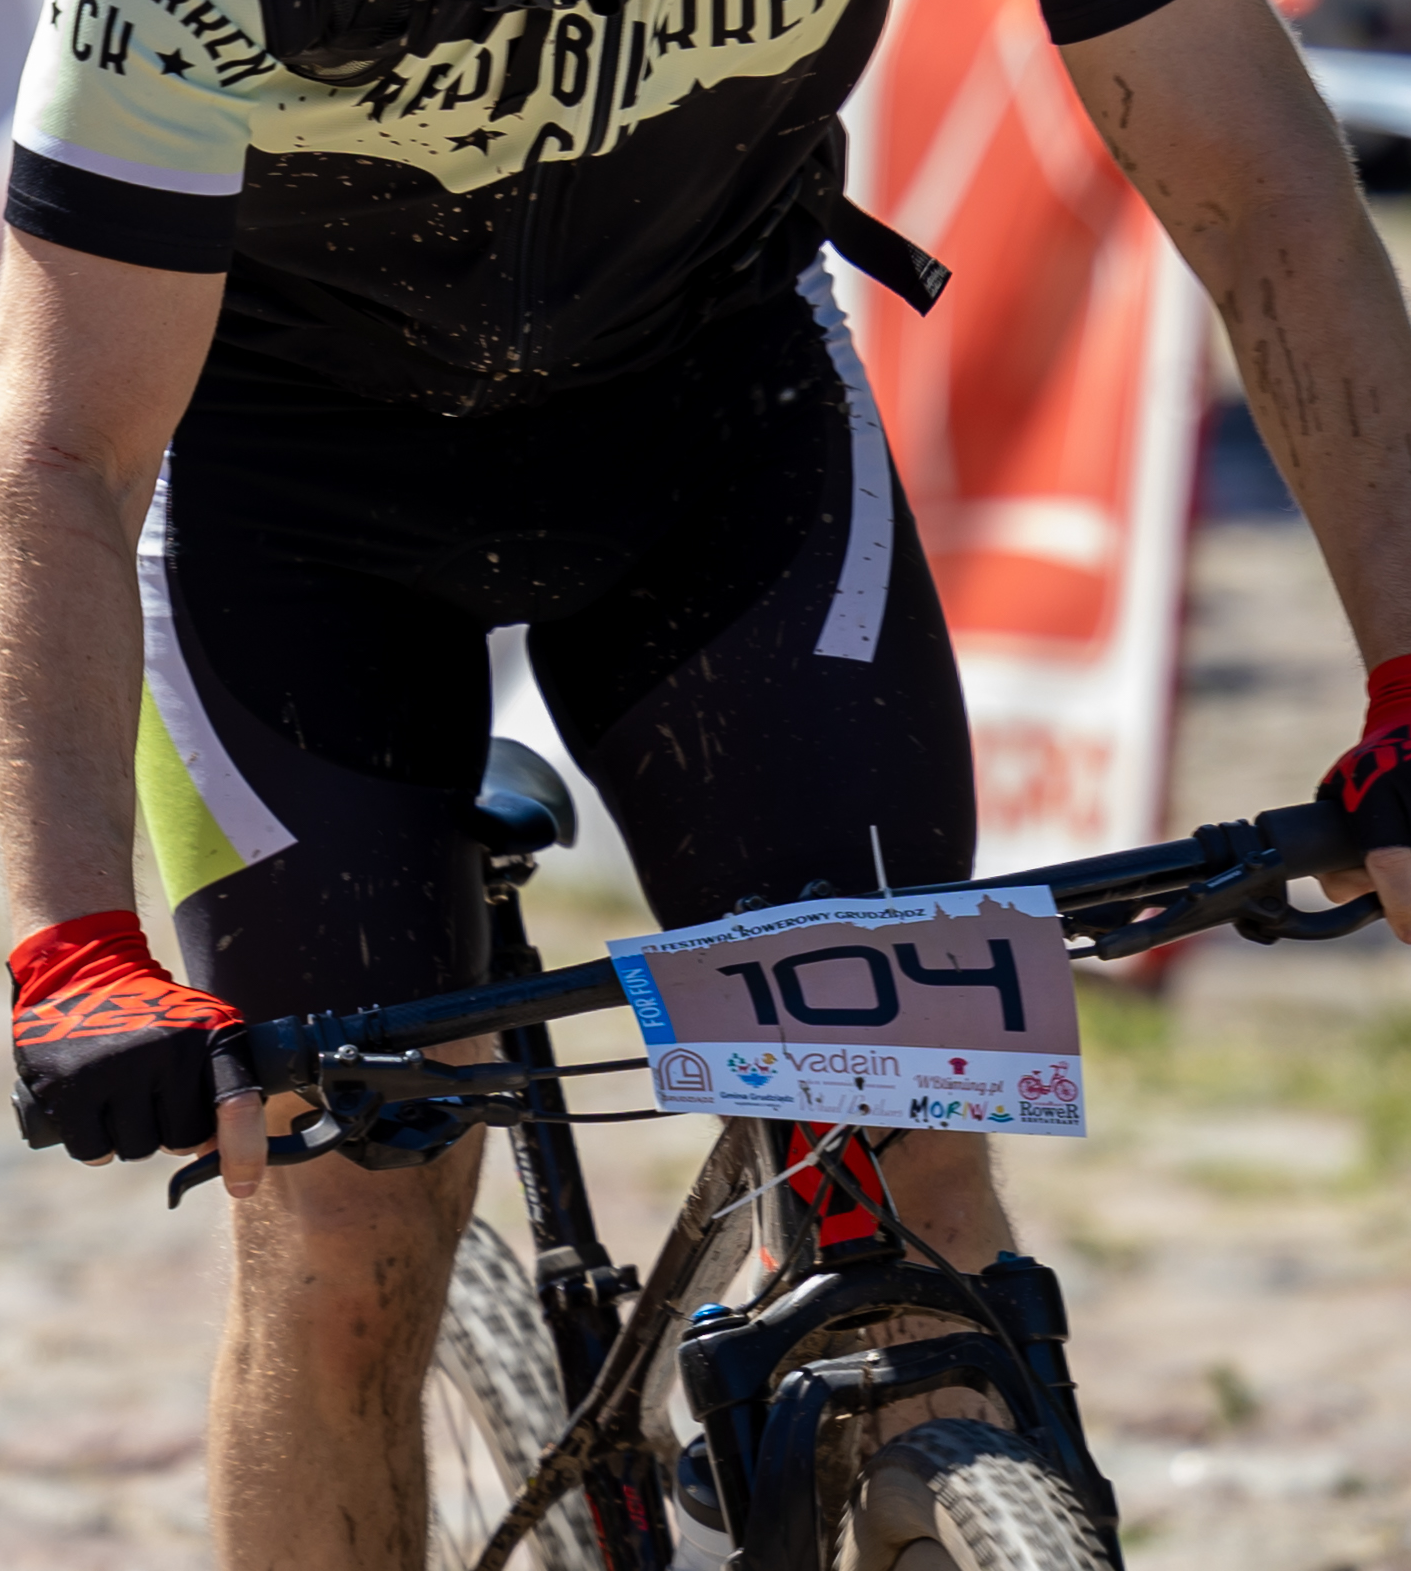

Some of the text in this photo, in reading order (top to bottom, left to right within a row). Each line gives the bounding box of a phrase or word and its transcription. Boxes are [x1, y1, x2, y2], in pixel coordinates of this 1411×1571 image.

[739, 912, 831, 937] ROWEROWY
[622, 968, 666, 1028] FOR FUN
[715, 937, 1027, 1033] 104
[785, 1048, 902, 1078] vadain
